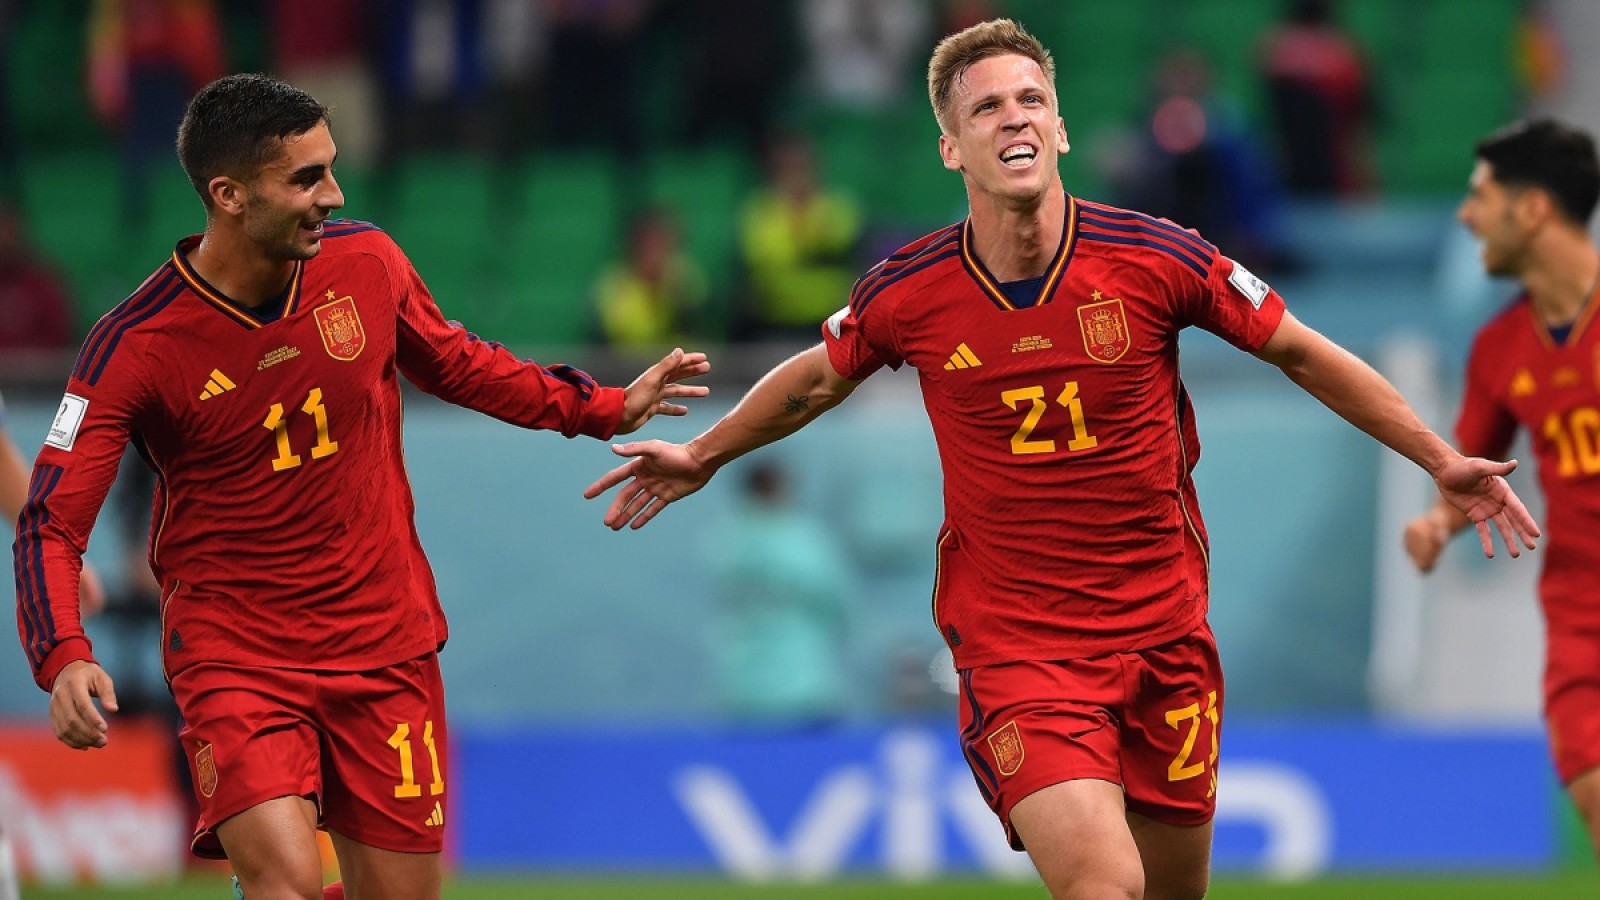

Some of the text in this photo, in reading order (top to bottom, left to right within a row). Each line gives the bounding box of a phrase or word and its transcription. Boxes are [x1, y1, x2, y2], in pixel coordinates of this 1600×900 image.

[263, 388, 338, 471] 11
[1001, 381, 1097, 454] 21
[1543, 407, 1600, 477] 10
[387, 721, 444, 797] 11
[1165, 690, 1219, 781] 21
